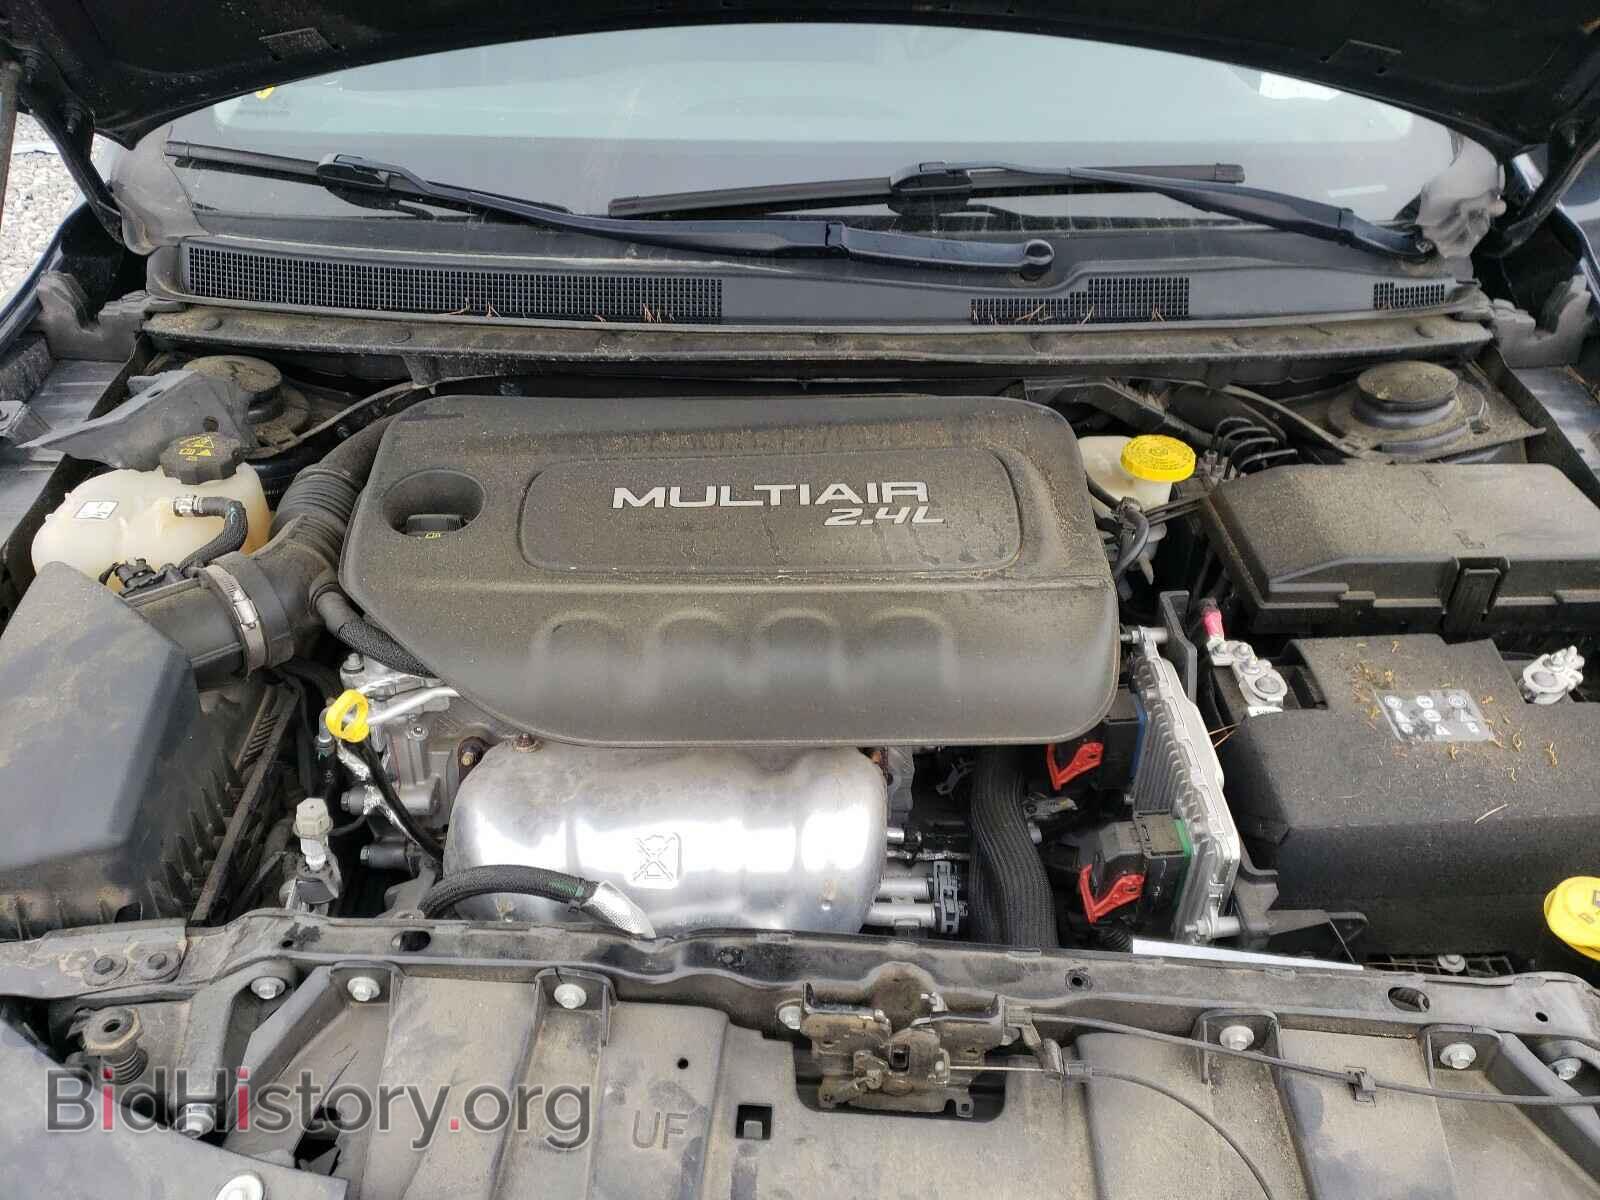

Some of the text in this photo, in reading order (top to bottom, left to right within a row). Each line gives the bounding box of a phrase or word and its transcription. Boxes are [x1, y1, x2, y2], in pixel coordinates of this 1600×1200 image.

[612, 482, 930, 508] MULTIAIR
[824, 505, 945, 526] 2.4L
[632, 1110, 689, 1149] UF
